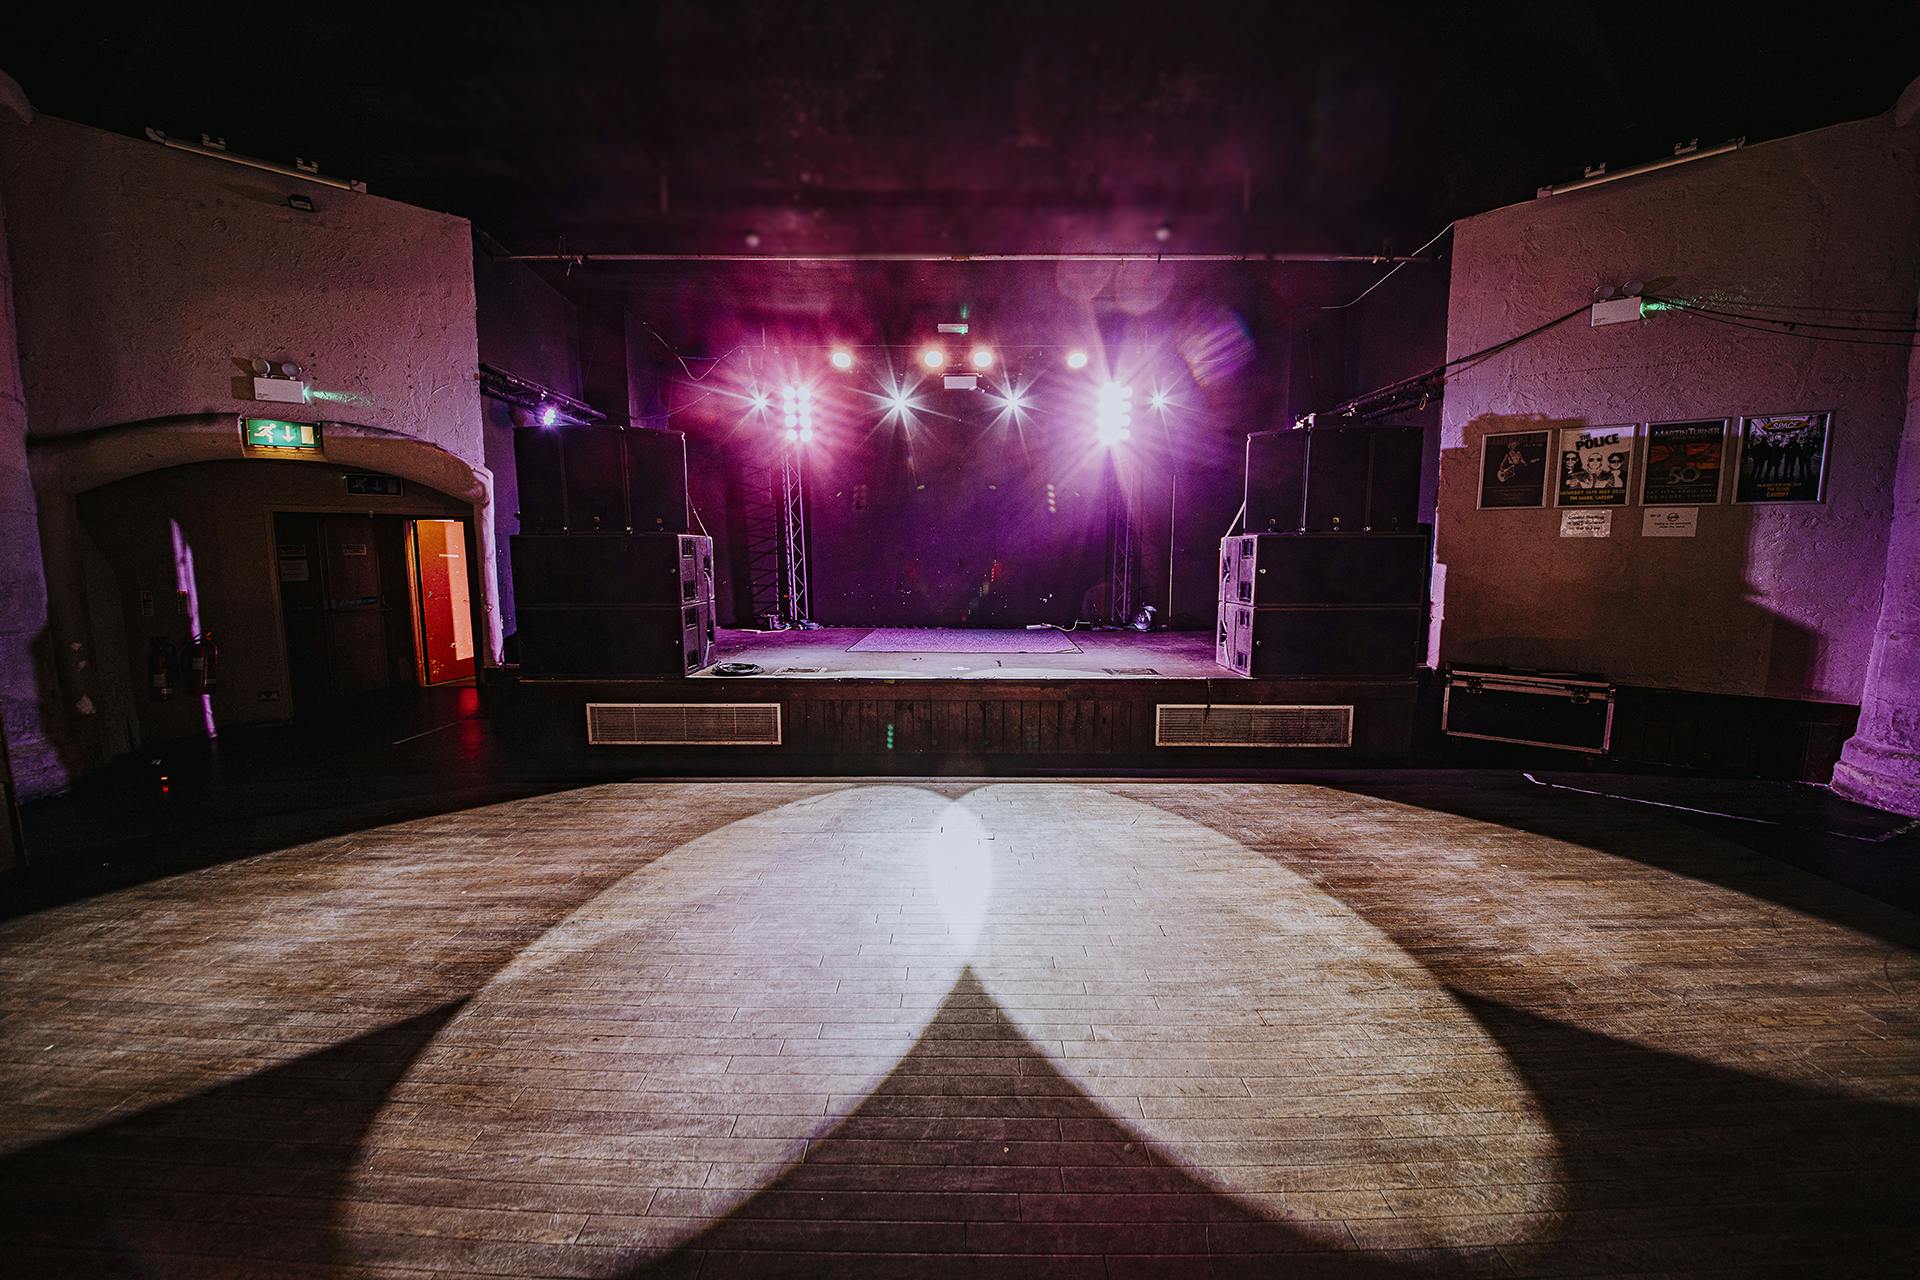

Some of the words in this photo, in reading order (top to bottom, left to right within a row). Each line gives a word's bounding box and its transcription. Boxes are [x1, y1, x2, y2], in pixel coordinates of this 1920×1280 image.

[1773, 421, 1799, 429] SPACE
[1654, 429, 1687, 437] MARTIN
[1575, 433, 1620, 451] POLICE
